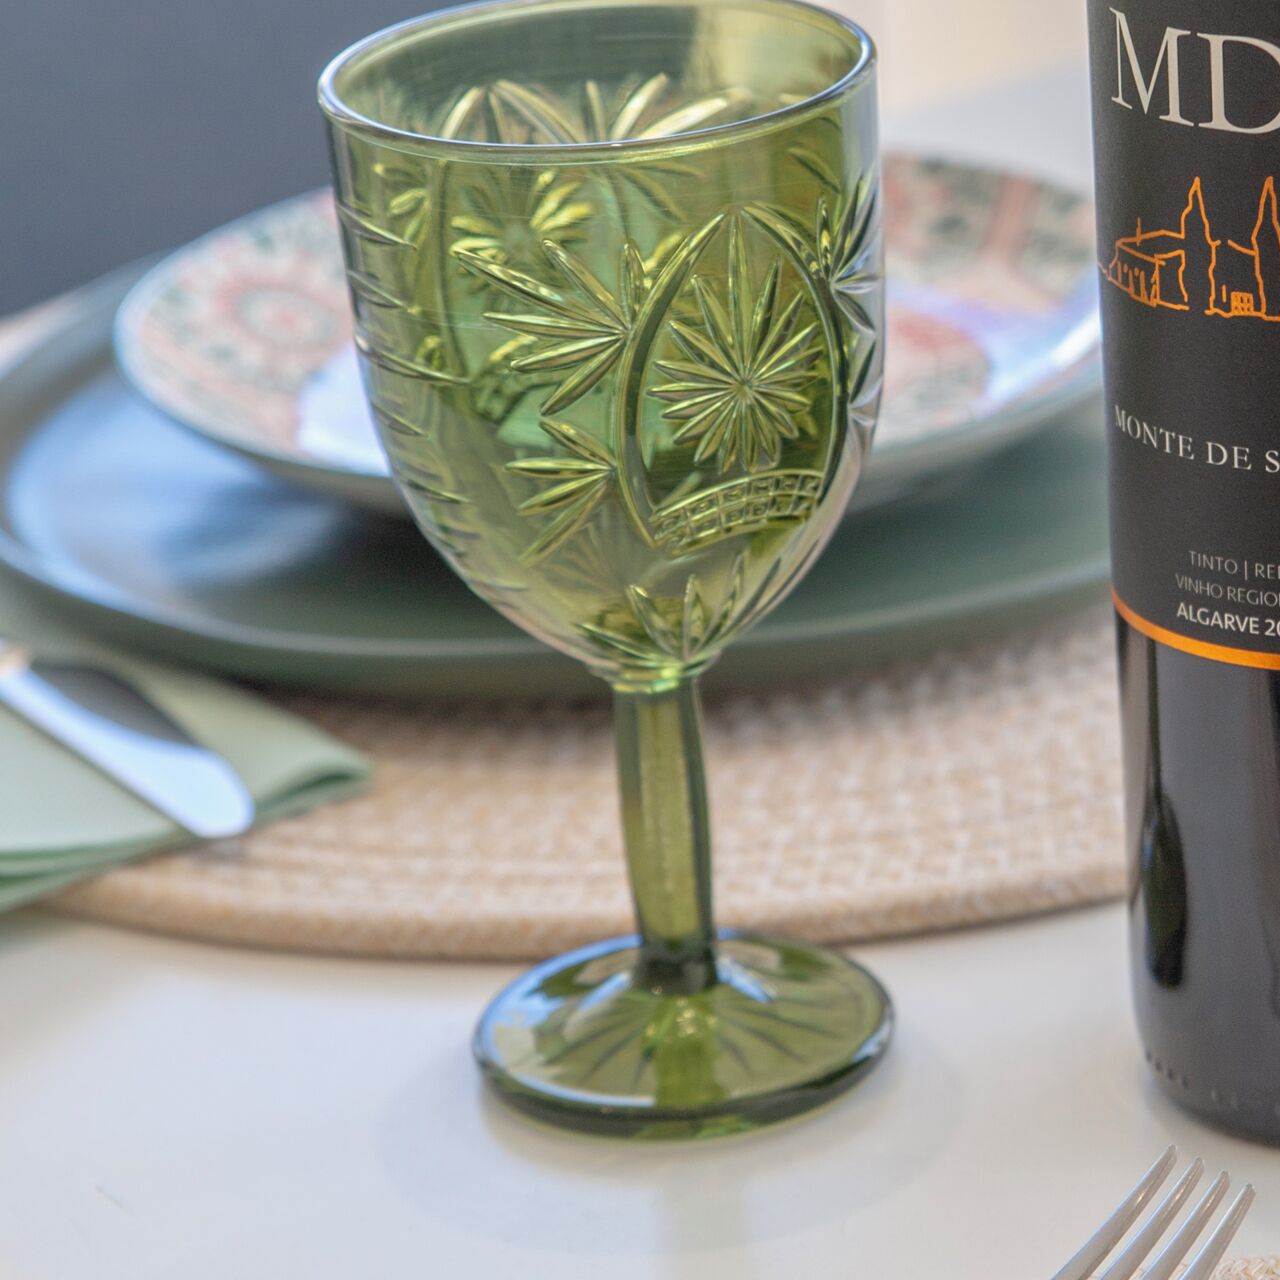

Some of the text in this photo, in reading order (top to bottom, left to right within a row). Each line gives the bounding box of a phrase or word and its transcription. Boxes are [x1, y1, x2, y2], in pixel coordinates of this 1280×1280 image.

[1114, 404, 1195, 460] MONTE
[1206, 441, 1252, 471] DE
[1188, 550, 1238, 575] TINTO
[1175, 573, 1223, 599] VINHO
[1176, 601, 1260, 635] ALGARVE
